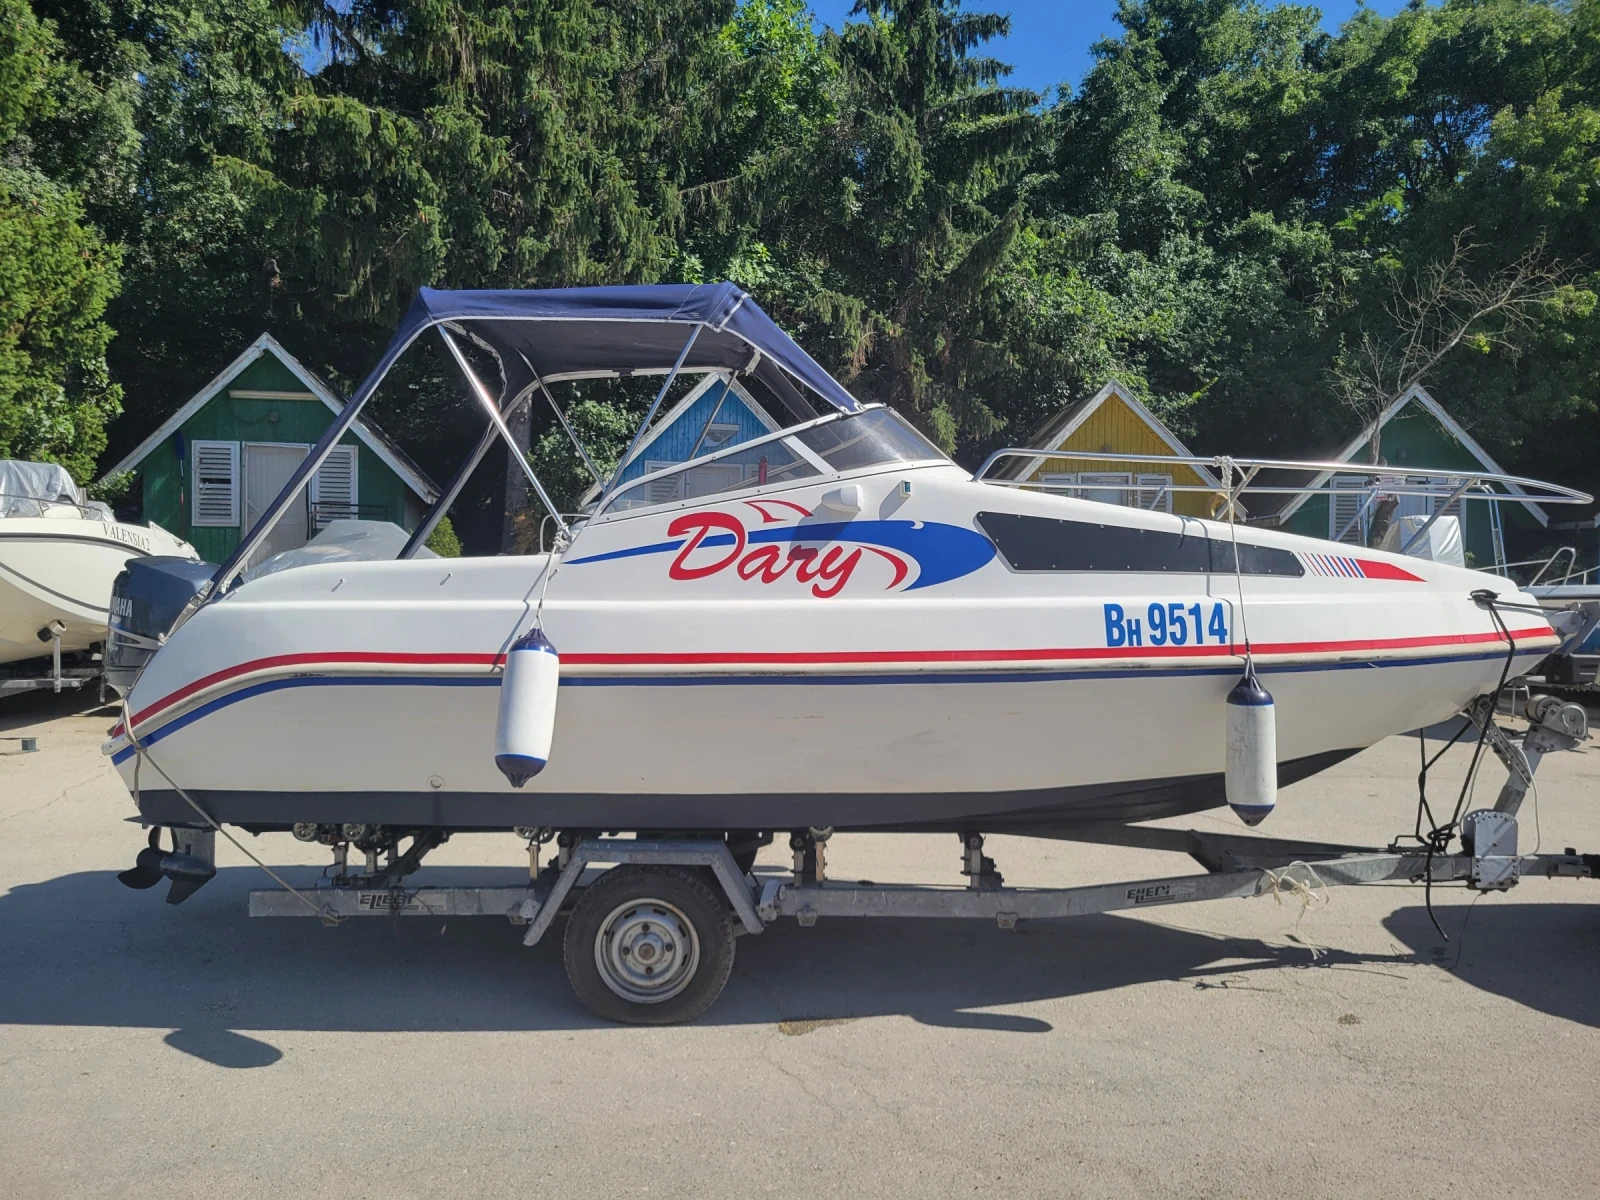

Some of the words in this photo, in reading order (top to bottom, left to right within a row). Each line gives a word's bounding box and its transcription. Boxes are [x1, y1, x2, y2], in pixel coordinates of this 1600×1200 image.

[102, 522, 146, 549] VALENSIA
[667, 511, 862, 599] Dary
[1147, 602, 1228, 646] 9514
